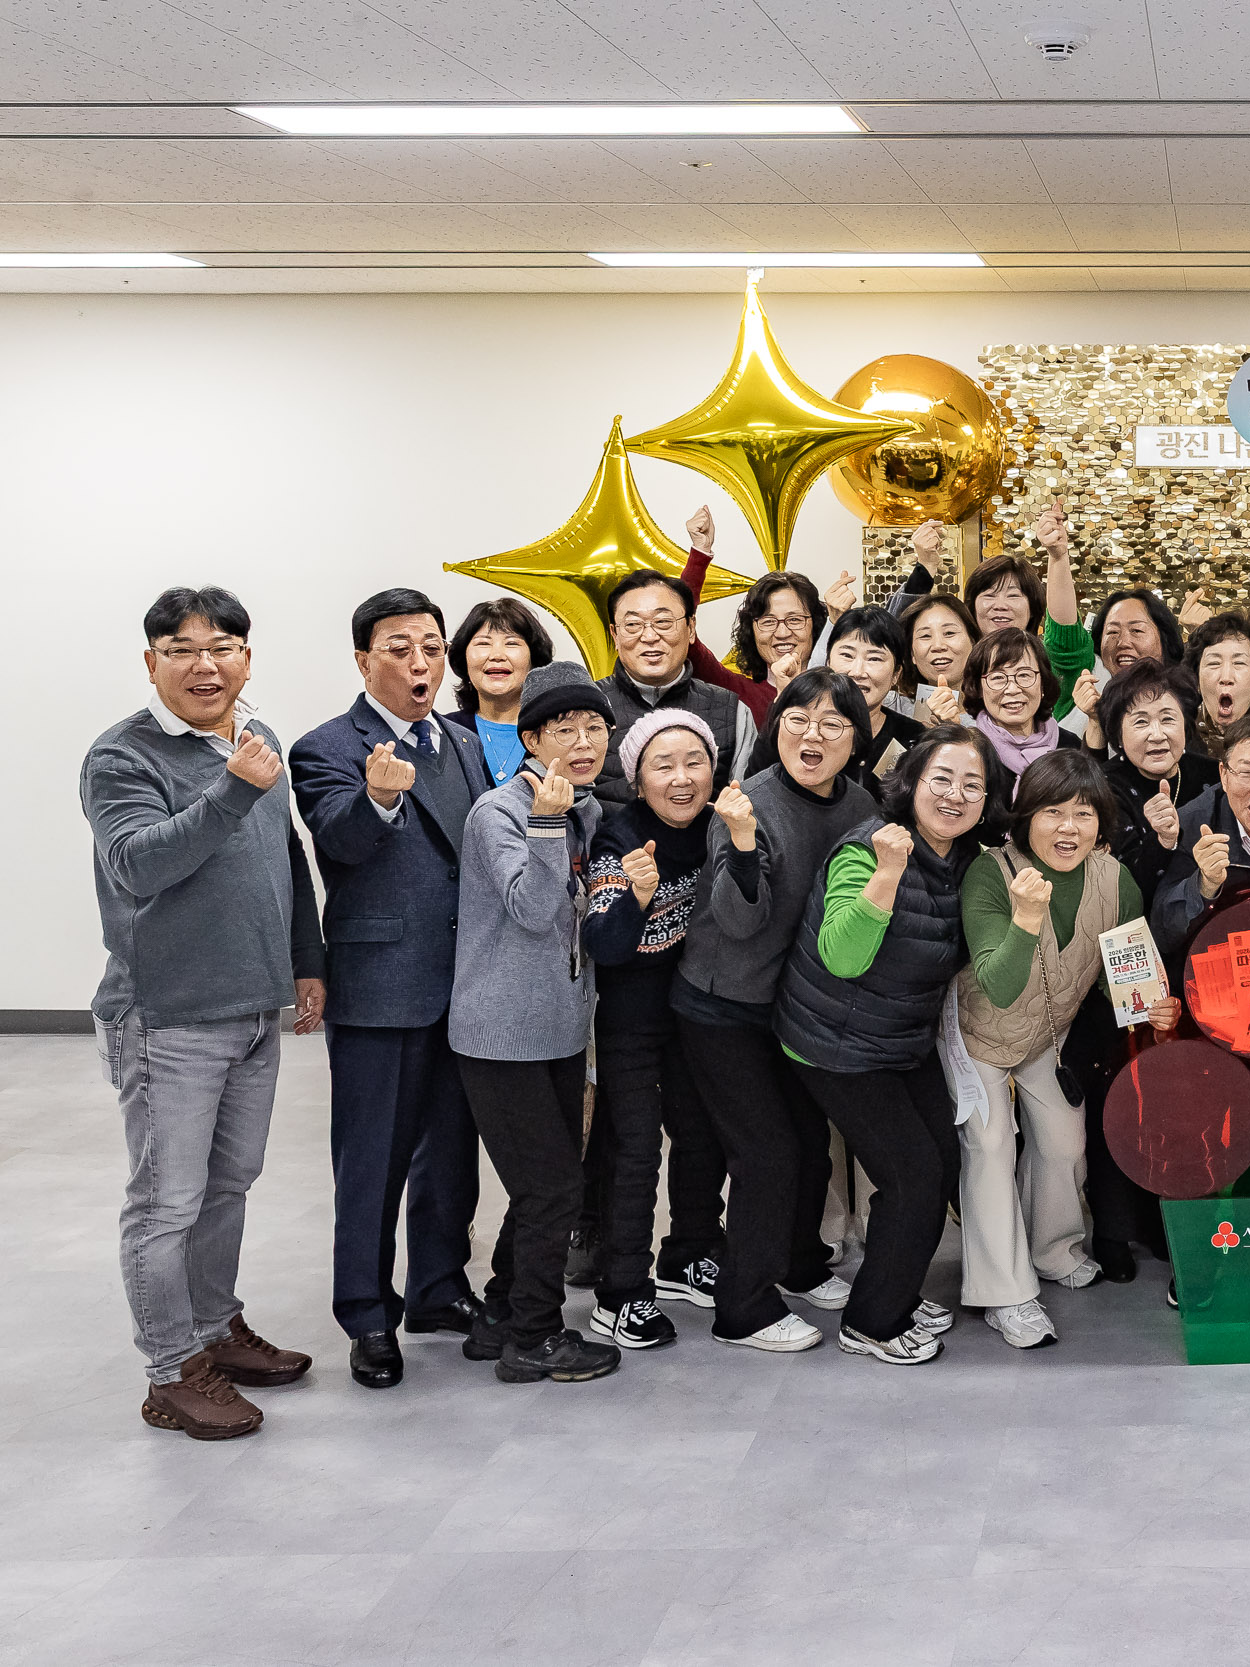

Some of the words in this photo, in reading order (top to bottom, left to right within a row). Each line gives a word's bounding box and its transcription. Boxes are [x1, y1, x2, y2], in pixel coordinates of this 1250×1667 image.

[1155, 431, 1209, 459] 광진
[1108, 949, 1123, 957] 2026
[1109, 949, 1147, 967] 따뜻한
[1112, 959, 1149, 975] 겨울나기
